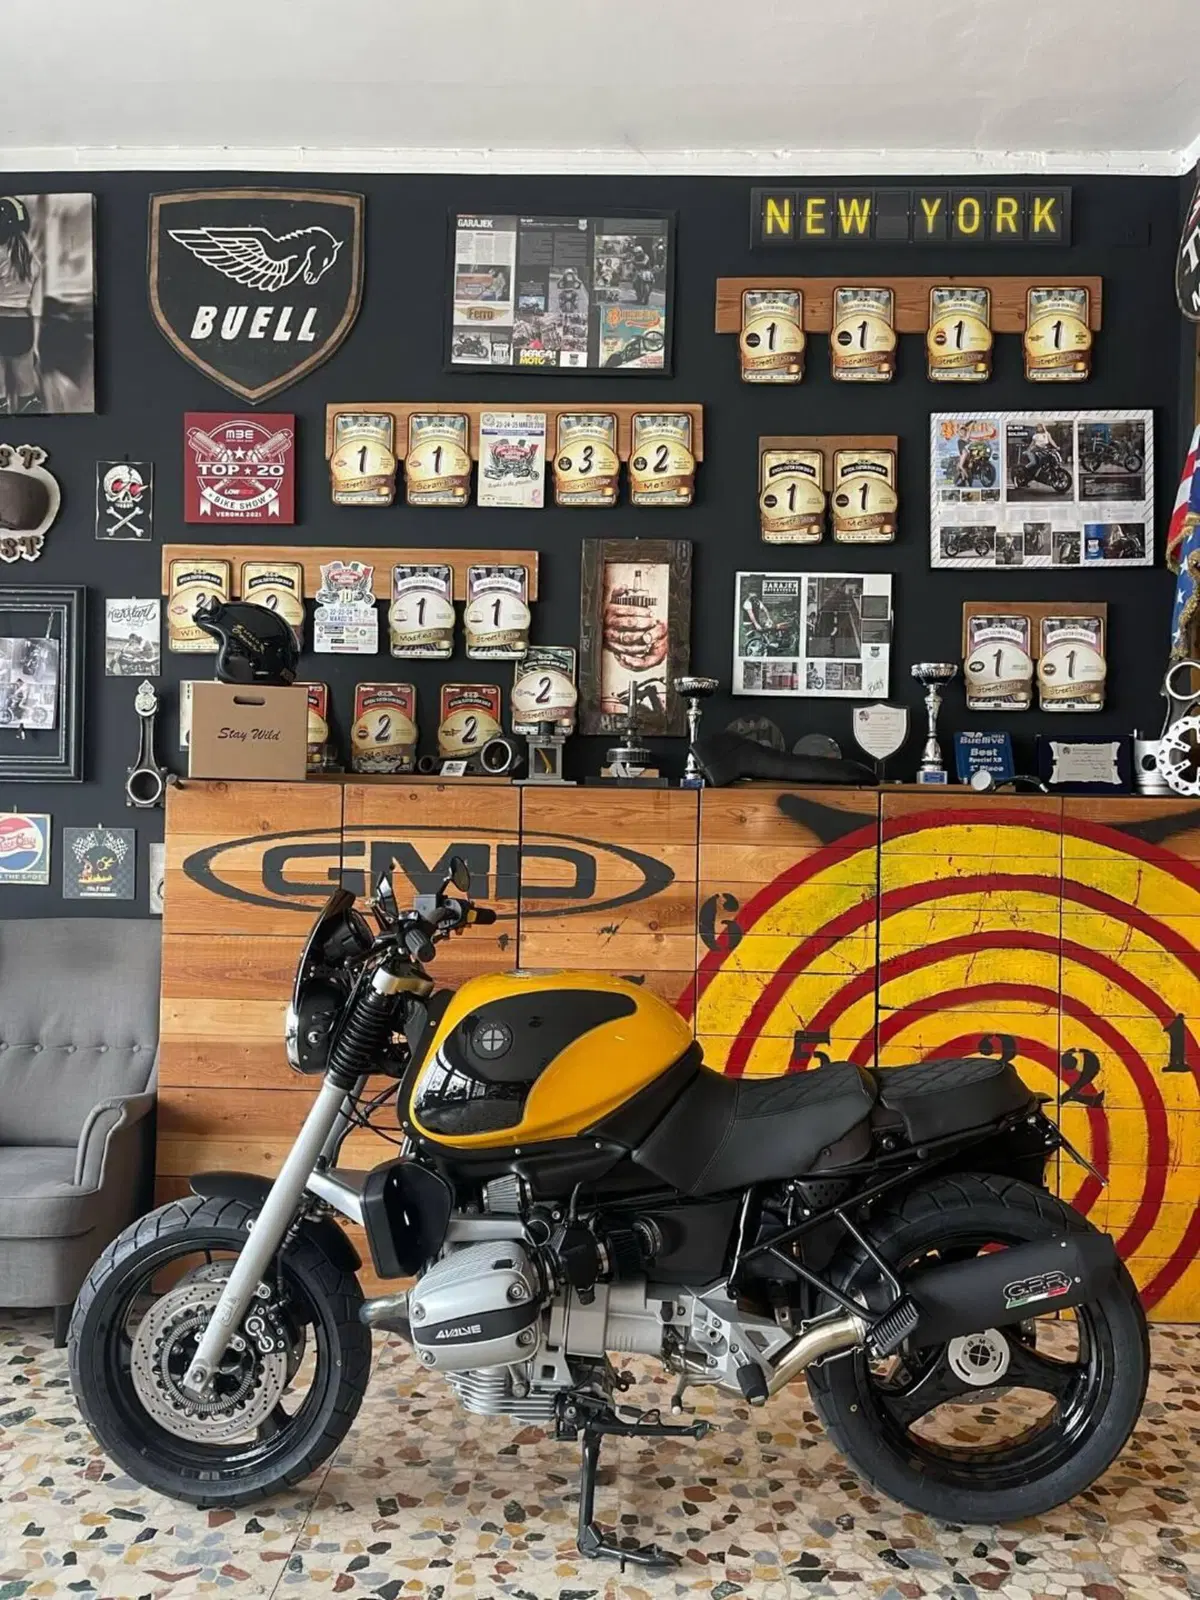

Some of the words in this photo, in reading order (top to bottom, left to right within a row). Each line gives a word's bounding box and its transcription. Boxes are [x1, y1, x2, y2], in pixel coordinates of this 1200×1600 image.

[766, 198, 871, 234] NEW
[920, 198, 1056, 234] YORK
[190, 305, 318, 342] BUELL
[766, 321, 777, 351] 1
[858, 320, 869, 350] 1
[954, 320, 964, 350] 1
[1052, 320, 1063, 350] 1
[197, 464, 240, 475] TOP
[256, 465, 284, 476] 20
[356, 445, 367, 473] 1
[432, 445, 442, 473] 1
[578, 445, 594, 474] 3
[653, 444, 670, 473] 2
[214, 496, 236, 509] BIKE
[239, 496, 266, 509] SHOW
[786, 483, 797, 511] 1
[858, 483, 868, 511] 1
[416, 597, 426, 626] 1
[491, 598, 501, 627] 1
[993, 649, 1003, 678] 1
[1065, 650, 1075, 679] 1
[535, 676, 552, 704] 2
[217, 727, 247, 742] Stay
[251, 728, 281, 741] Wild
[375, 714, 391, 742] 2
[462, 715, 479, 744] 2
[970, 748, 998, 756] Best
[262, 841, 596, 900] GMD
[699, 893, 744, 952] 6
[1163, 1013, 1192, 1072] 1
[1061, 1048, 1105, 1105] 2
